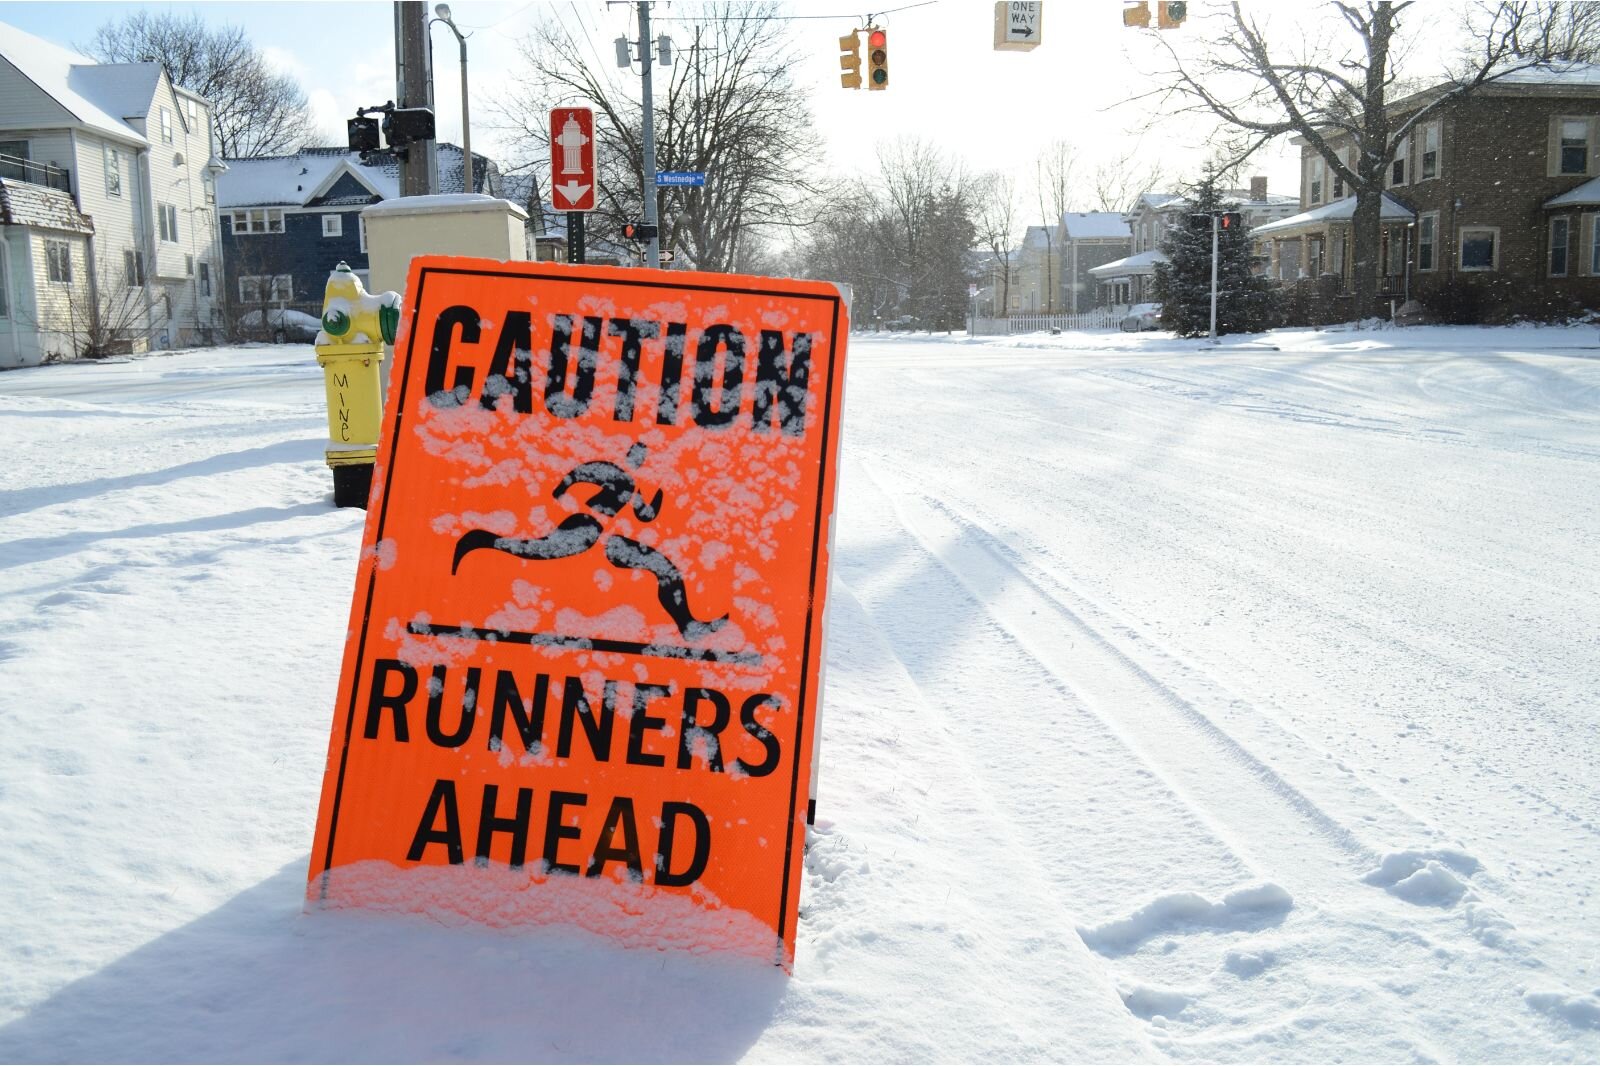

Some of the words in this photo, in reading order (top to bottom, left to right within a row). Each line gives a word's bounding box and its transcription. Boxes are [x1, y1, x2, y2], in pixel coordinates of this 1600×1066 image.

[1011, 13, 1035, 23] WAY
[1012, 1, 1035, 12] ONE
[663, 174, 696, 184] Westnedge
[424, 305, 812, 437] CAUTION
[363, 658, 782, 778] RUNNERS
[406, 779, 711, 887] AHEAD
